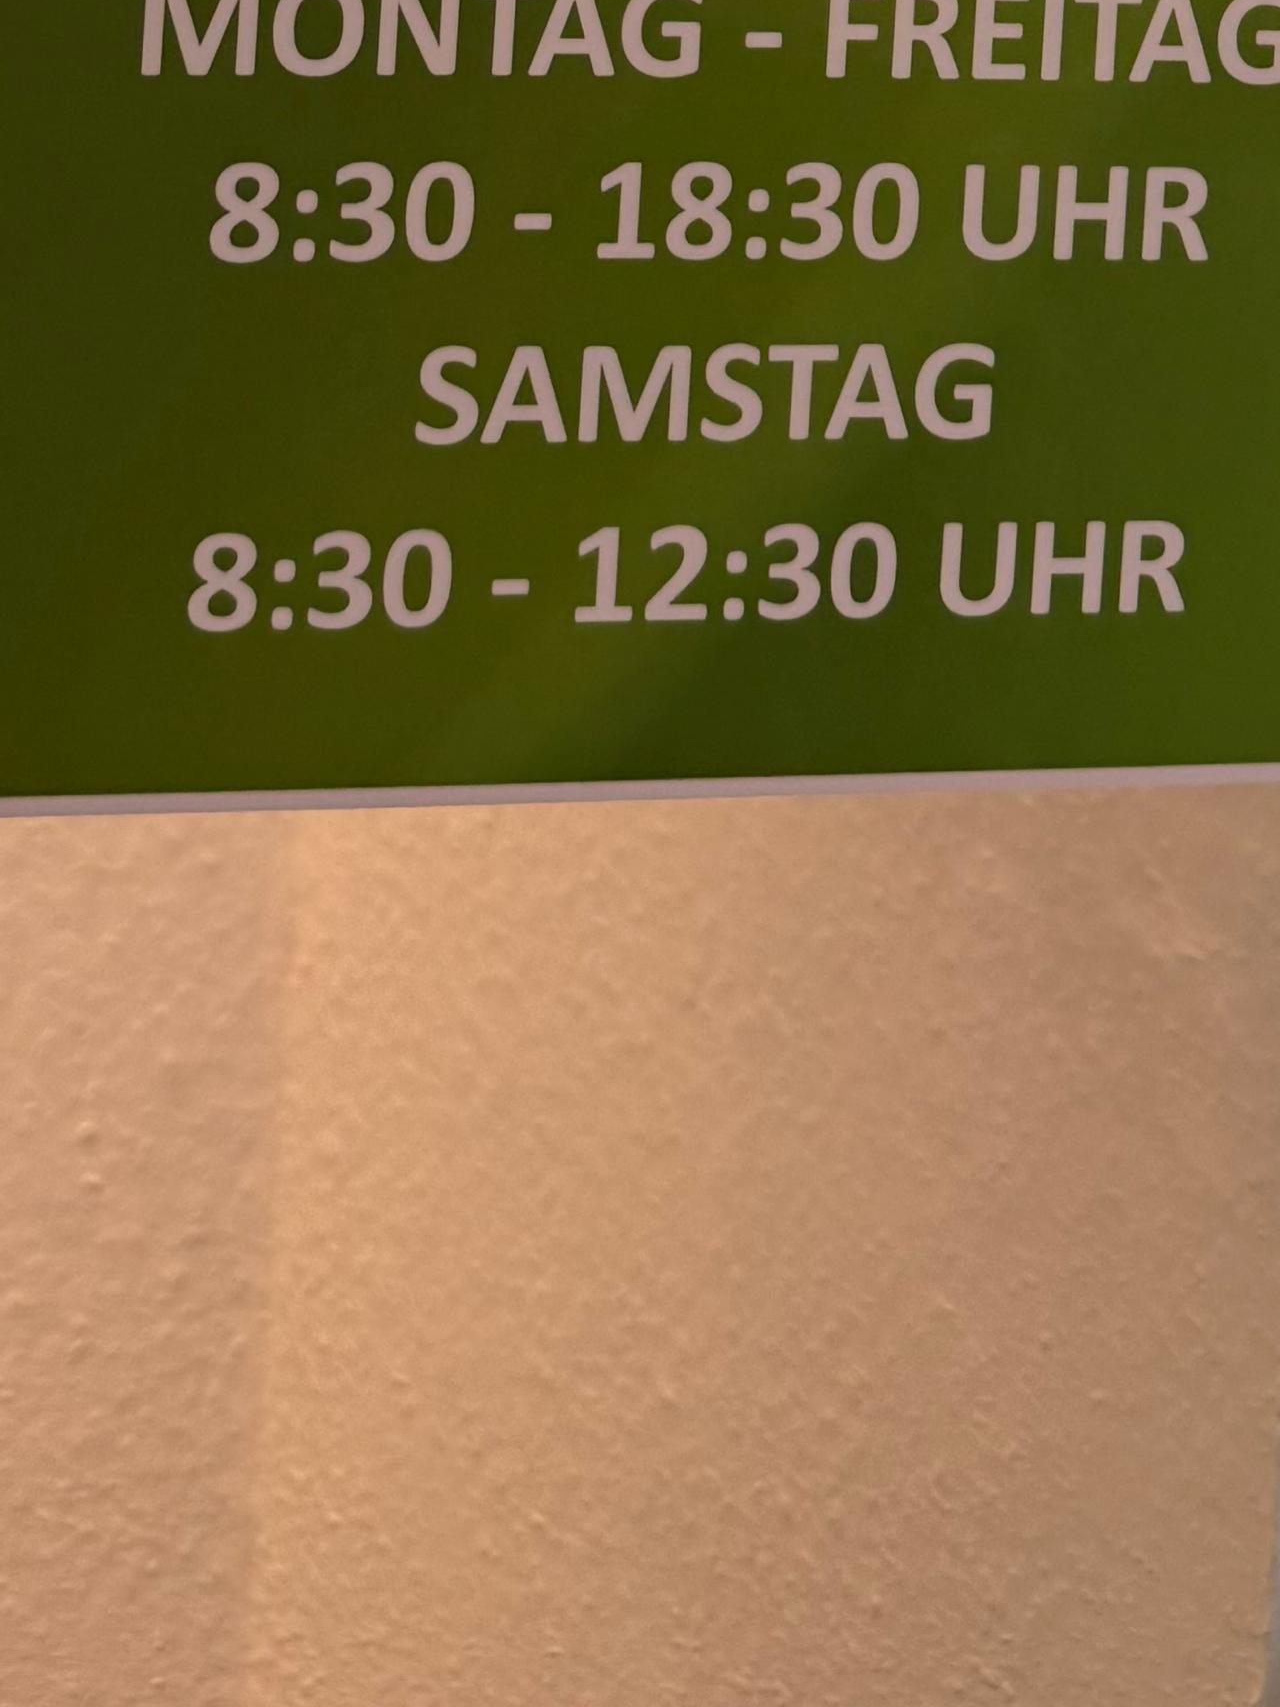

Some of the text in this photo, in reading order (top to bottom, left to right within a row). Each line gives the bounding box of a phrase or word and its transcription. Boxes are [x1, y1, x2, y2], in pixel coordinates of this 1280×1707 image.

[744, 31, 783, 49] -
[209, 161, 1209, 264] 8:30 - 18:30 UHR
[414, 342, 995, 446] SAMSTAG
[187, 520, 1185, 633] 8:30 - 12:30 UHR
